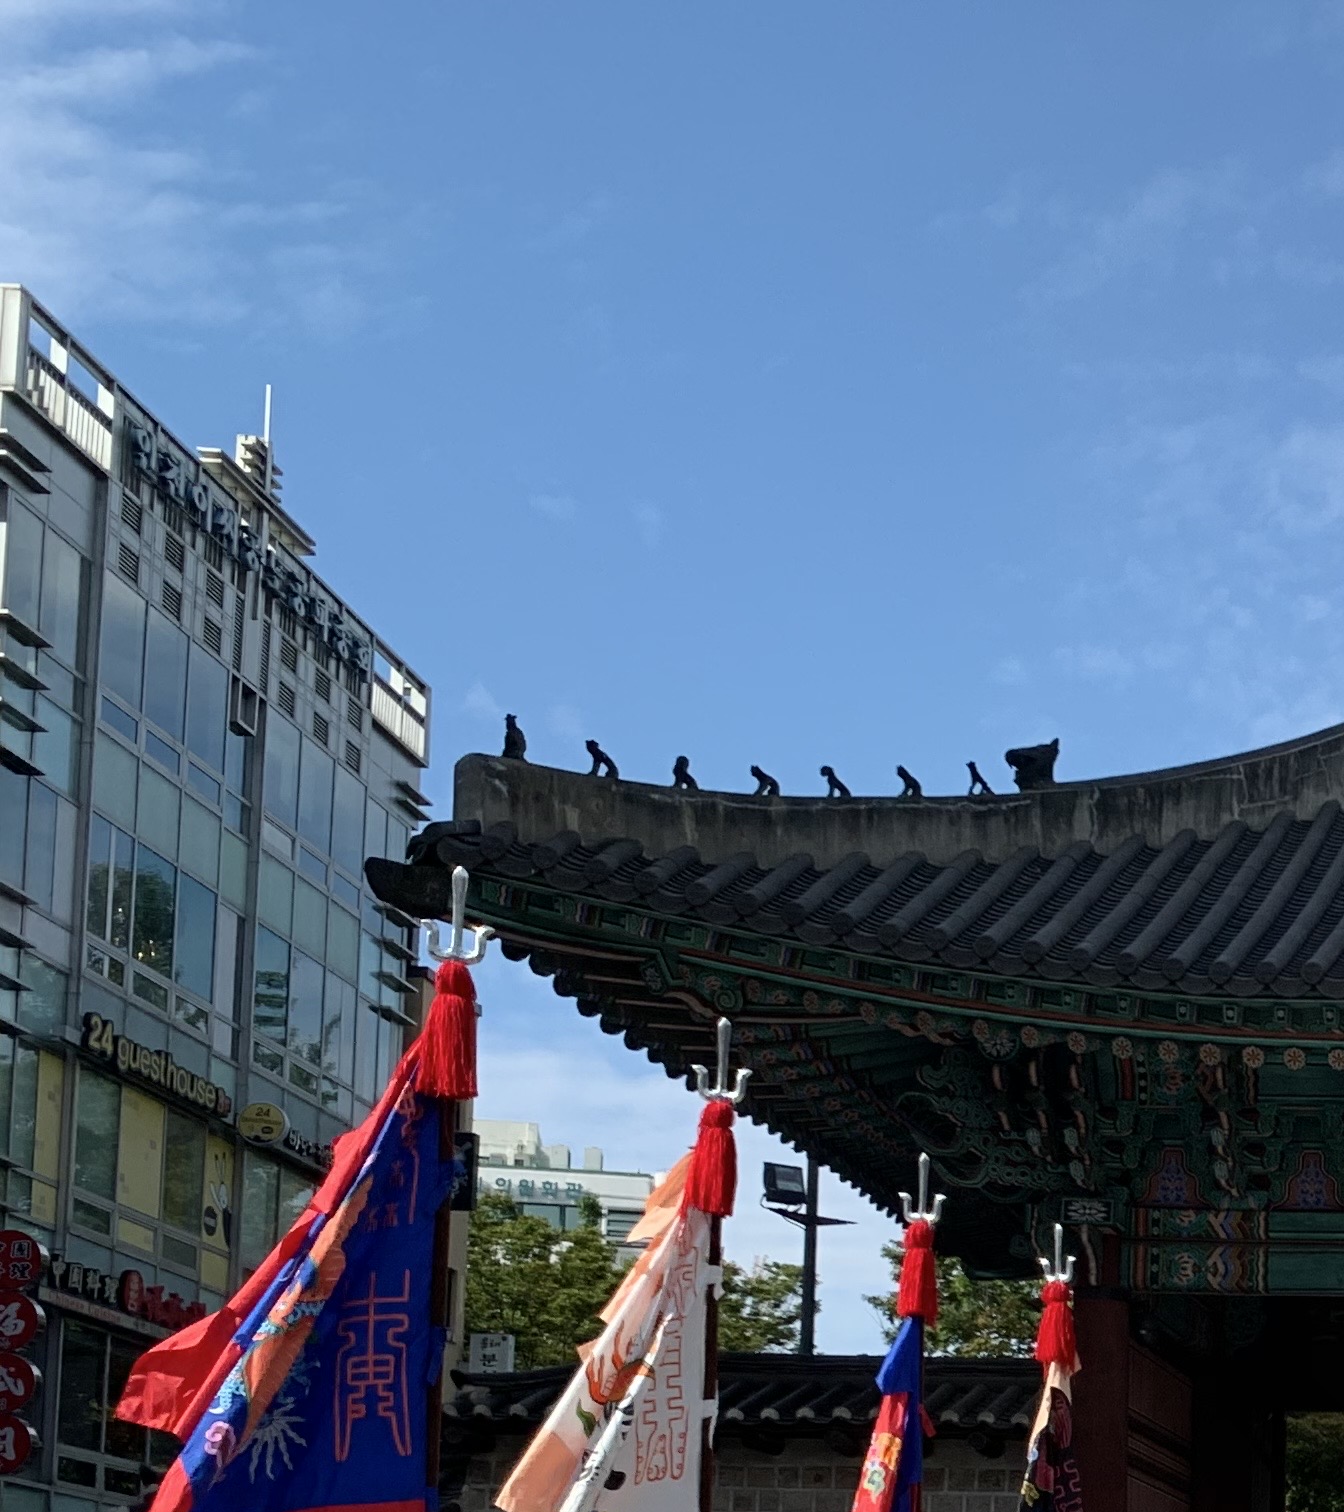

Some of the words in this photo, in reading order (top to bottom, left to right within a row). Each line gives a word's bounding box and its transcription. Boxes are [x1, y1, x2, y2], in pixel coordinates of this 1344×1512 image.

[88, 1014, 114, 1059] 24
[117, 1038, 217, 1110] guesthouse
[255, 1106, 270, 1118] 24
